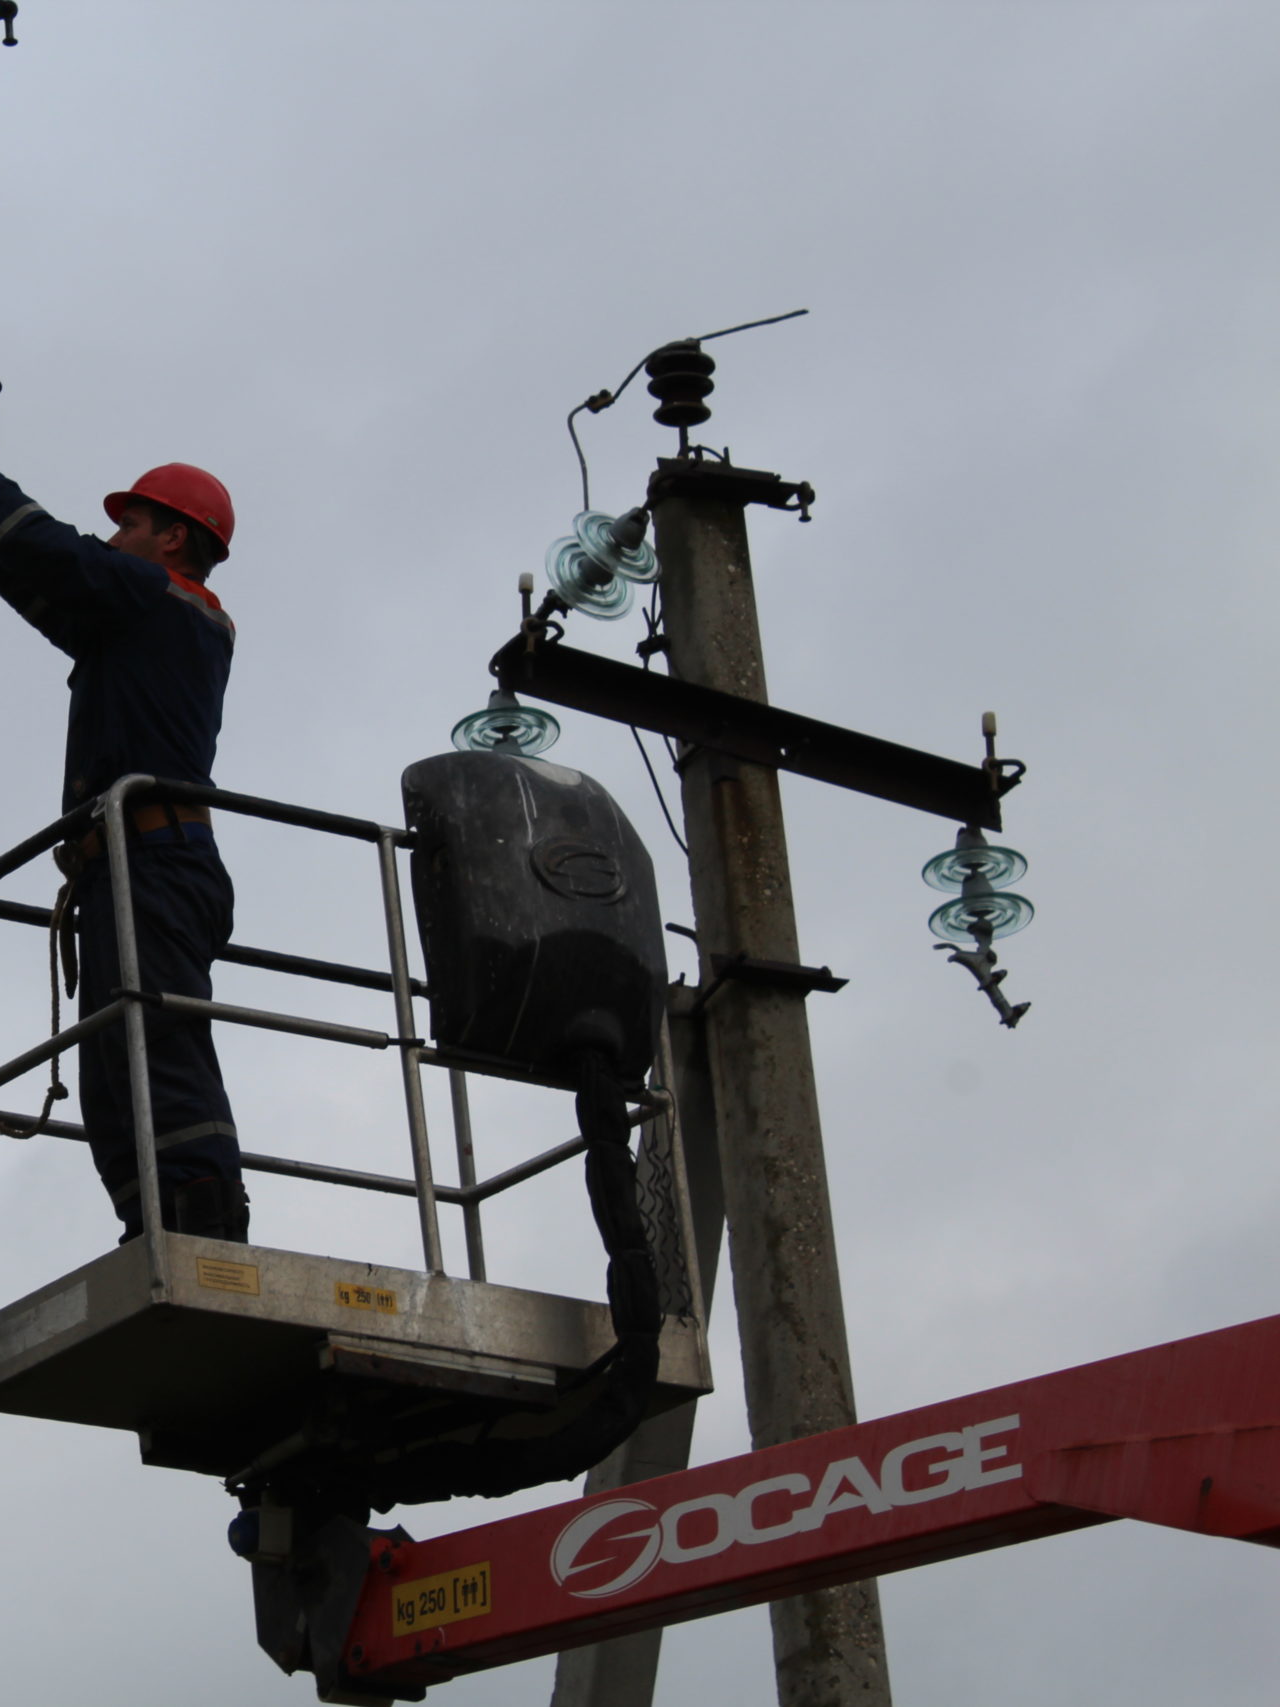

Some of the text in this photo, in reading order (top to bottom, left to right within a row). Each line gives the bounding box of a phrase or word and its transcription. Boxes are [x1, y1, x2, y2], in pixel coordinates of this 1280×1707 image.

[356, 1290, 371, 1304] 250
[550, 1414, 1023, 1599] SOCAGE
[397, 1587, 445, 1625] kg 250
